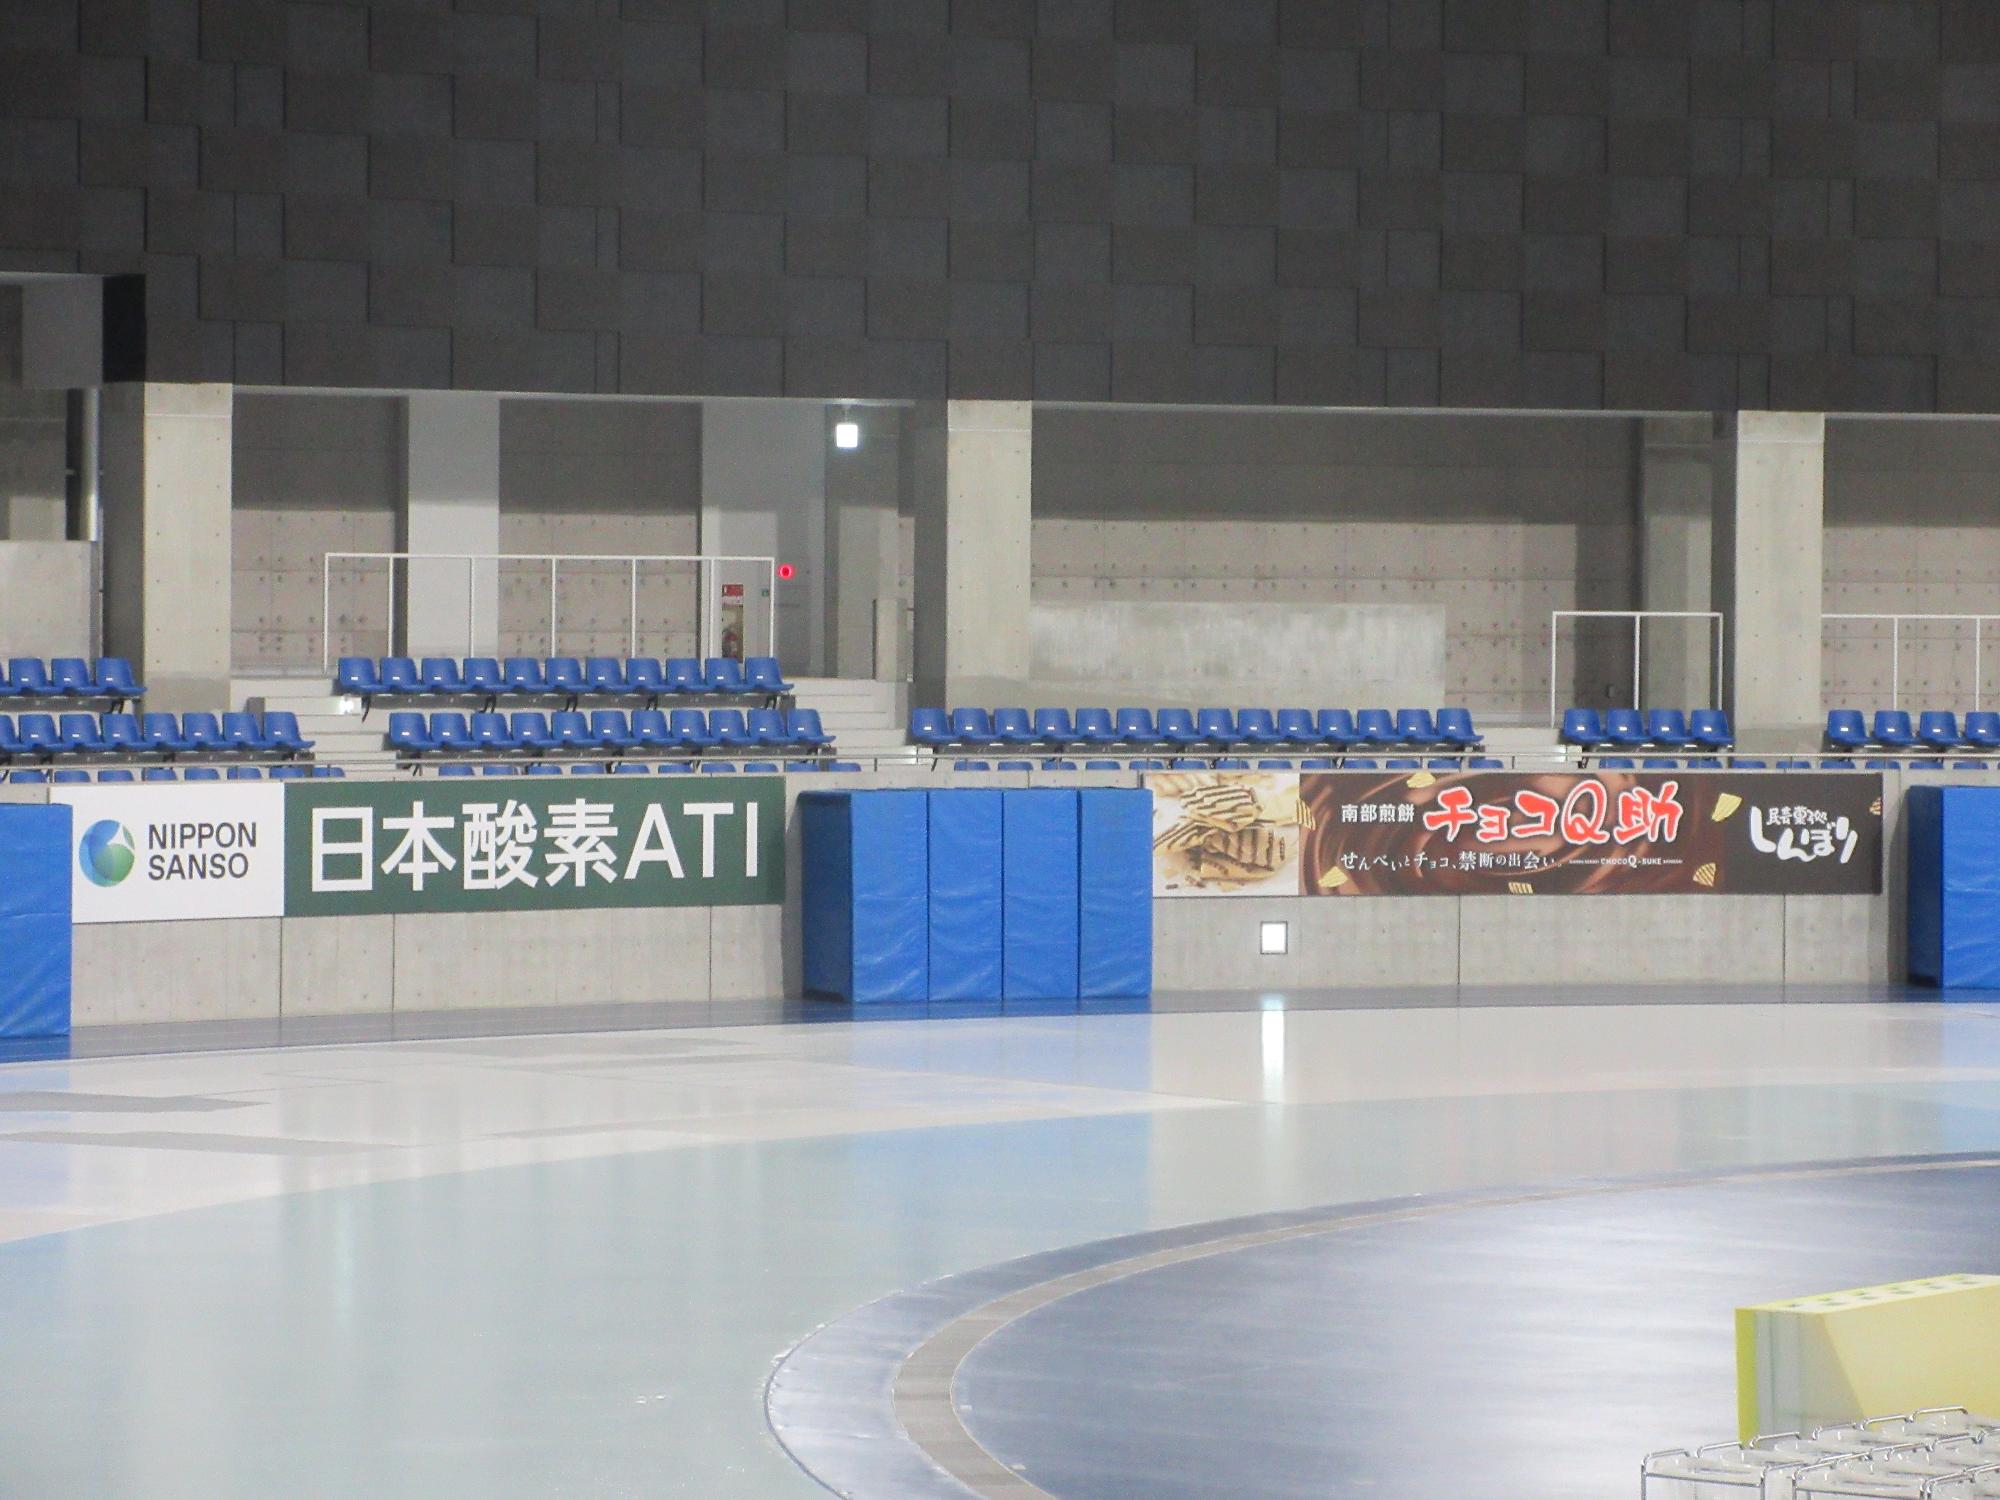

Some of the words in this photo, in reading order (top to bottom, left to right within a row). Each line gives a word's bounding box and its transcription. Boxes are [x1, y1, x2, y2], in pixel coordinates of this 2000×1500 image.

[148, 822, 257, 849] NIPPON
[1341, 803, 1415, 823] 南部煎餅
[1423, 779, 1684, 845] チョコQ助
[1750, 805, 1858, 864] しんぼり
[147, 852, 249, 881] SANSO
[311, 798, 758, 892] 日本酸素ATI
